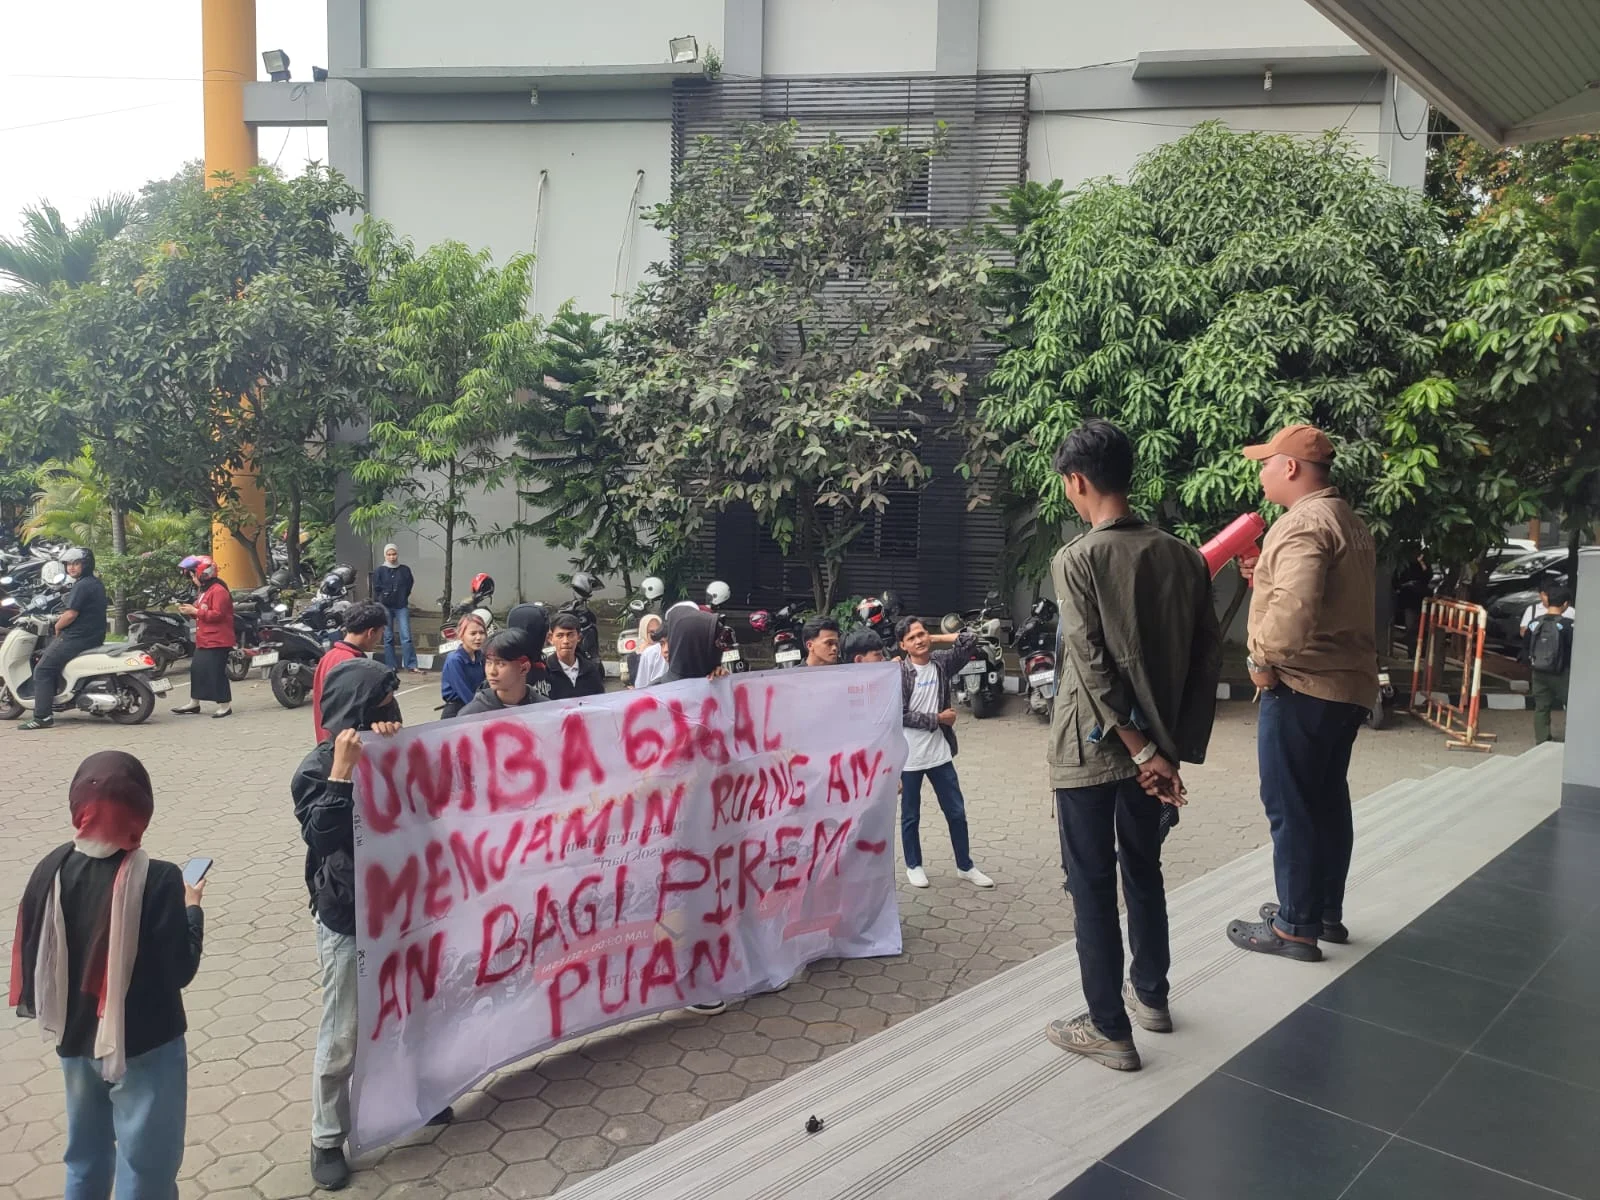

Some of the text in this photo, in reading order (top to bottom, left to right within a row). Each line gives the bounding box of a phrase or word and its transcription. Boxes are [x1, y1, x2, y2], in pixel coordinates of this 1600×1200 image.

[358, 713, 606, 834] UNIBA
[364, 783, 684, 939] MENJAMIN
[711, 754, 811, 831] RUANG
[371, 932, 444, 1041] AN
[476, 864, 629, 987] BAGI
[549, 933, 731, 1038] PUAN
